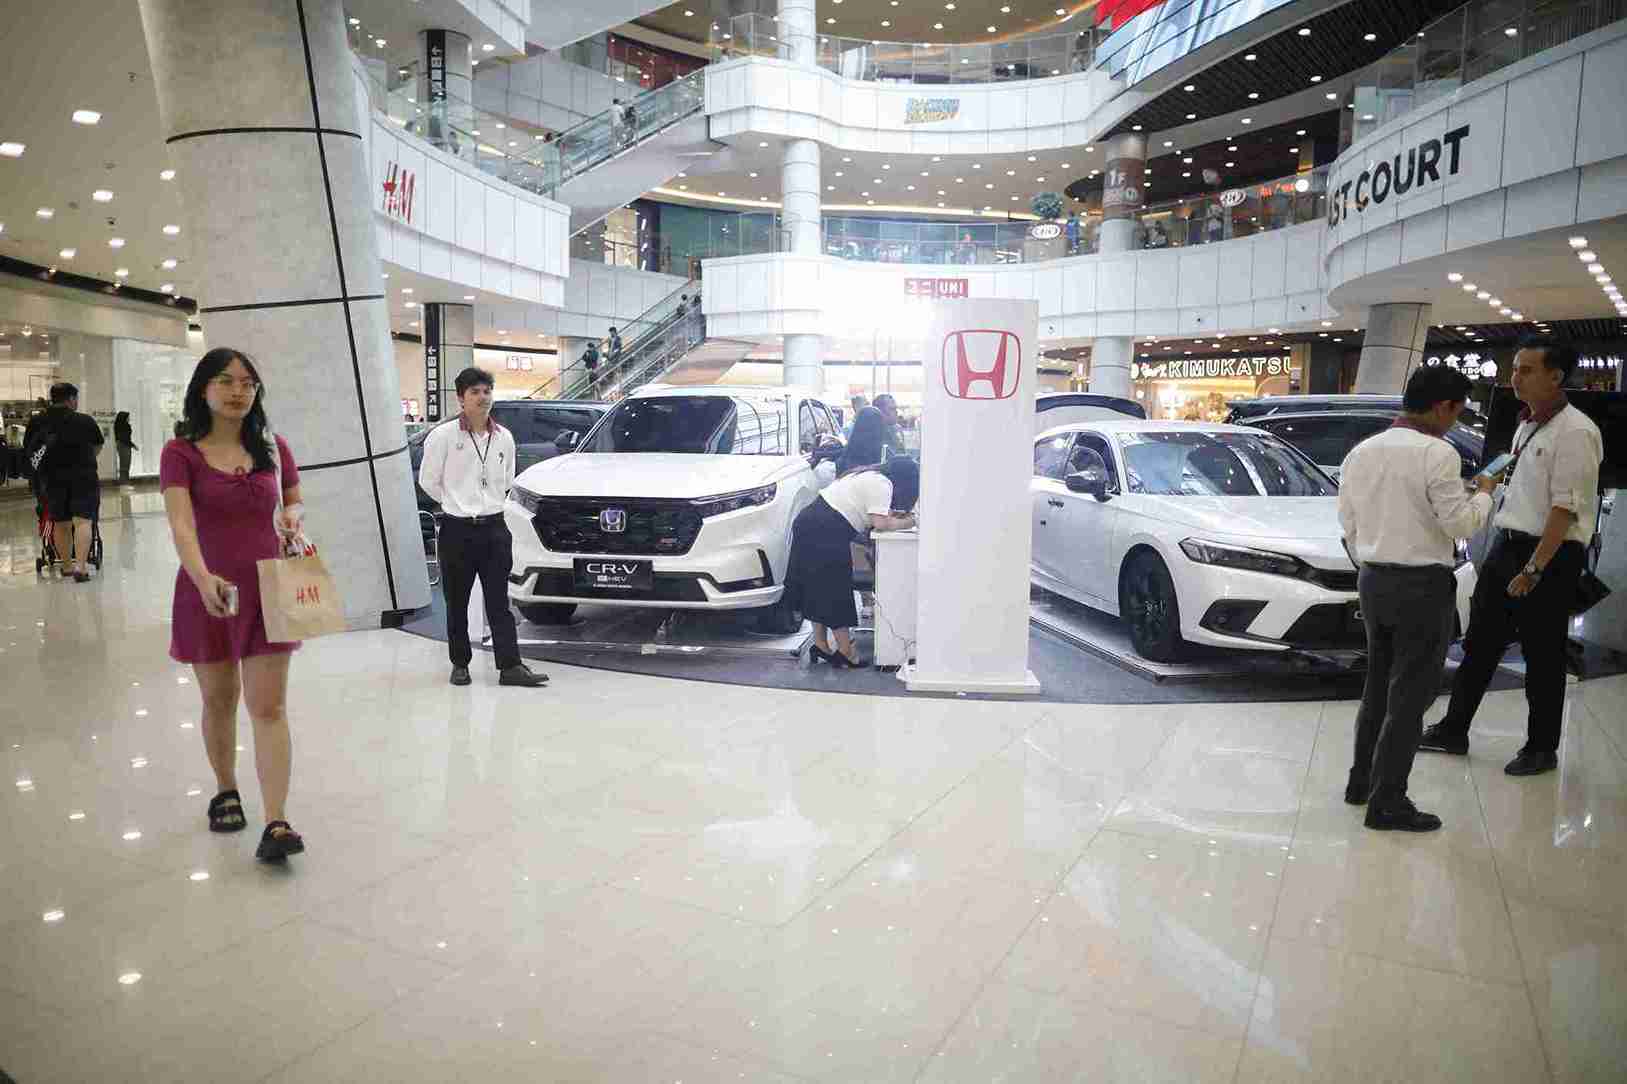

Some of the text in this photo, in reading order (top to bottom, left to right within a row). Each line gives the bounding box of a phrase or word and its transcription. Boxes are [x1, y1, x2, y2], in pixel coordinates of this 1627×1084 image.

[1356, 124, 1470, 212] COURT
[586, 563, 638, 574] CR-V
[296, 585, 321, 605] HM
